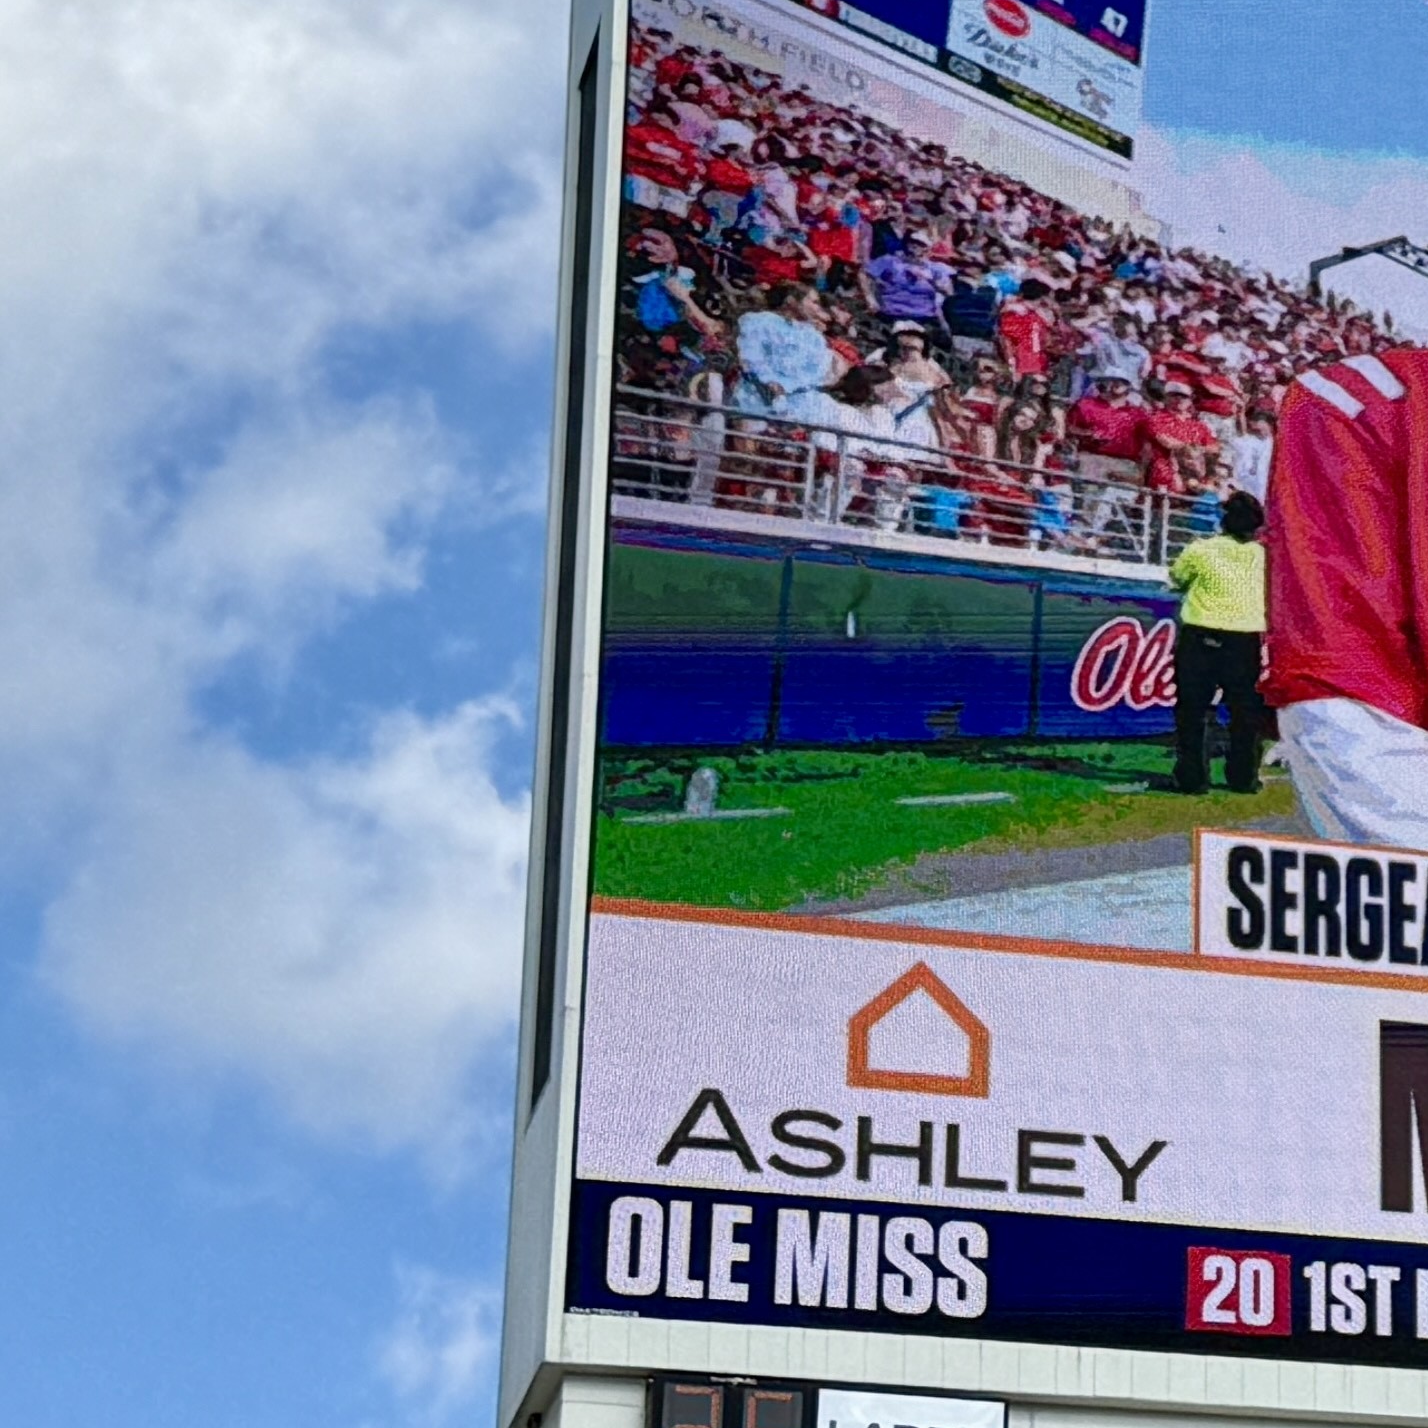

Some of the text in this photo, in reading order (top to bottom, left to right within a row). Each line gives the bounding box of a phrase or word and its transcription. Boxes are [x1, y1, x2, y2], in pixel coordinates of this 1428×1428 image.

[1070, 616, 1178, 712] Ole
[655, 1087, 1170, 1204] ASHLEY
[605, 1195, 989, 1319] OLE MISS
[1201, 1255, 1275, 1328] 20
[1302, 1259, 1401, 1339] 1ST
